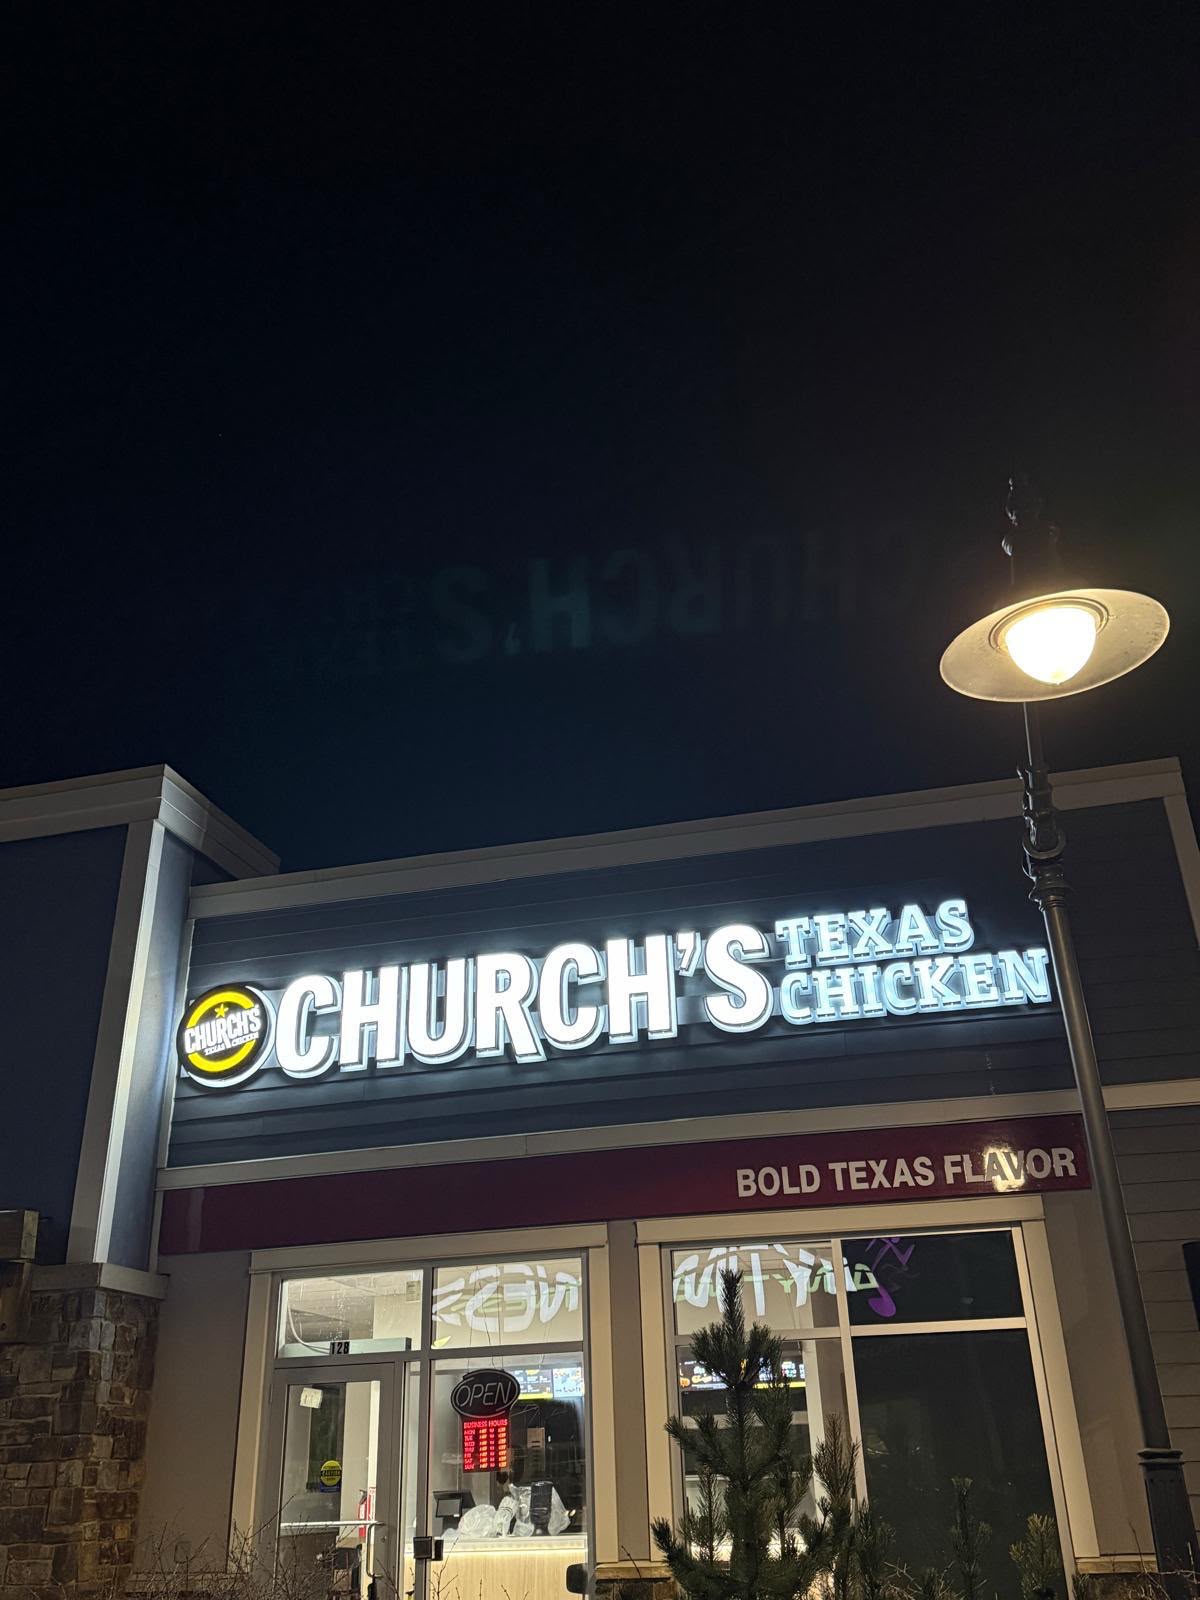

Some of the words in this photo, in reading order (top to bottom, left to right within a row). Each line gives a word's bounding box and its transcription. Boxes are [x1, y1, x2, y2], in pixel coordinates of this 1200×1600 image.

[775, 899, 975, 969] TEXAS
[275, 924, 772, 1078] CHURCH'S
[780, 948, 1052, 1025] CHICKEN
[184, 1007, 261, 1053] CHURCH'S
[736, 1164, 821, 1198] BOLD
[828, 1157, 935, 1191] TEXAS
[943, 1147, 1078, 1185] FLAVOR
[331, 1341, 350, 1354] 128
[456, 1381, 512, 1407] OPEN
[488, 1419, 508, 1427] HOURS
